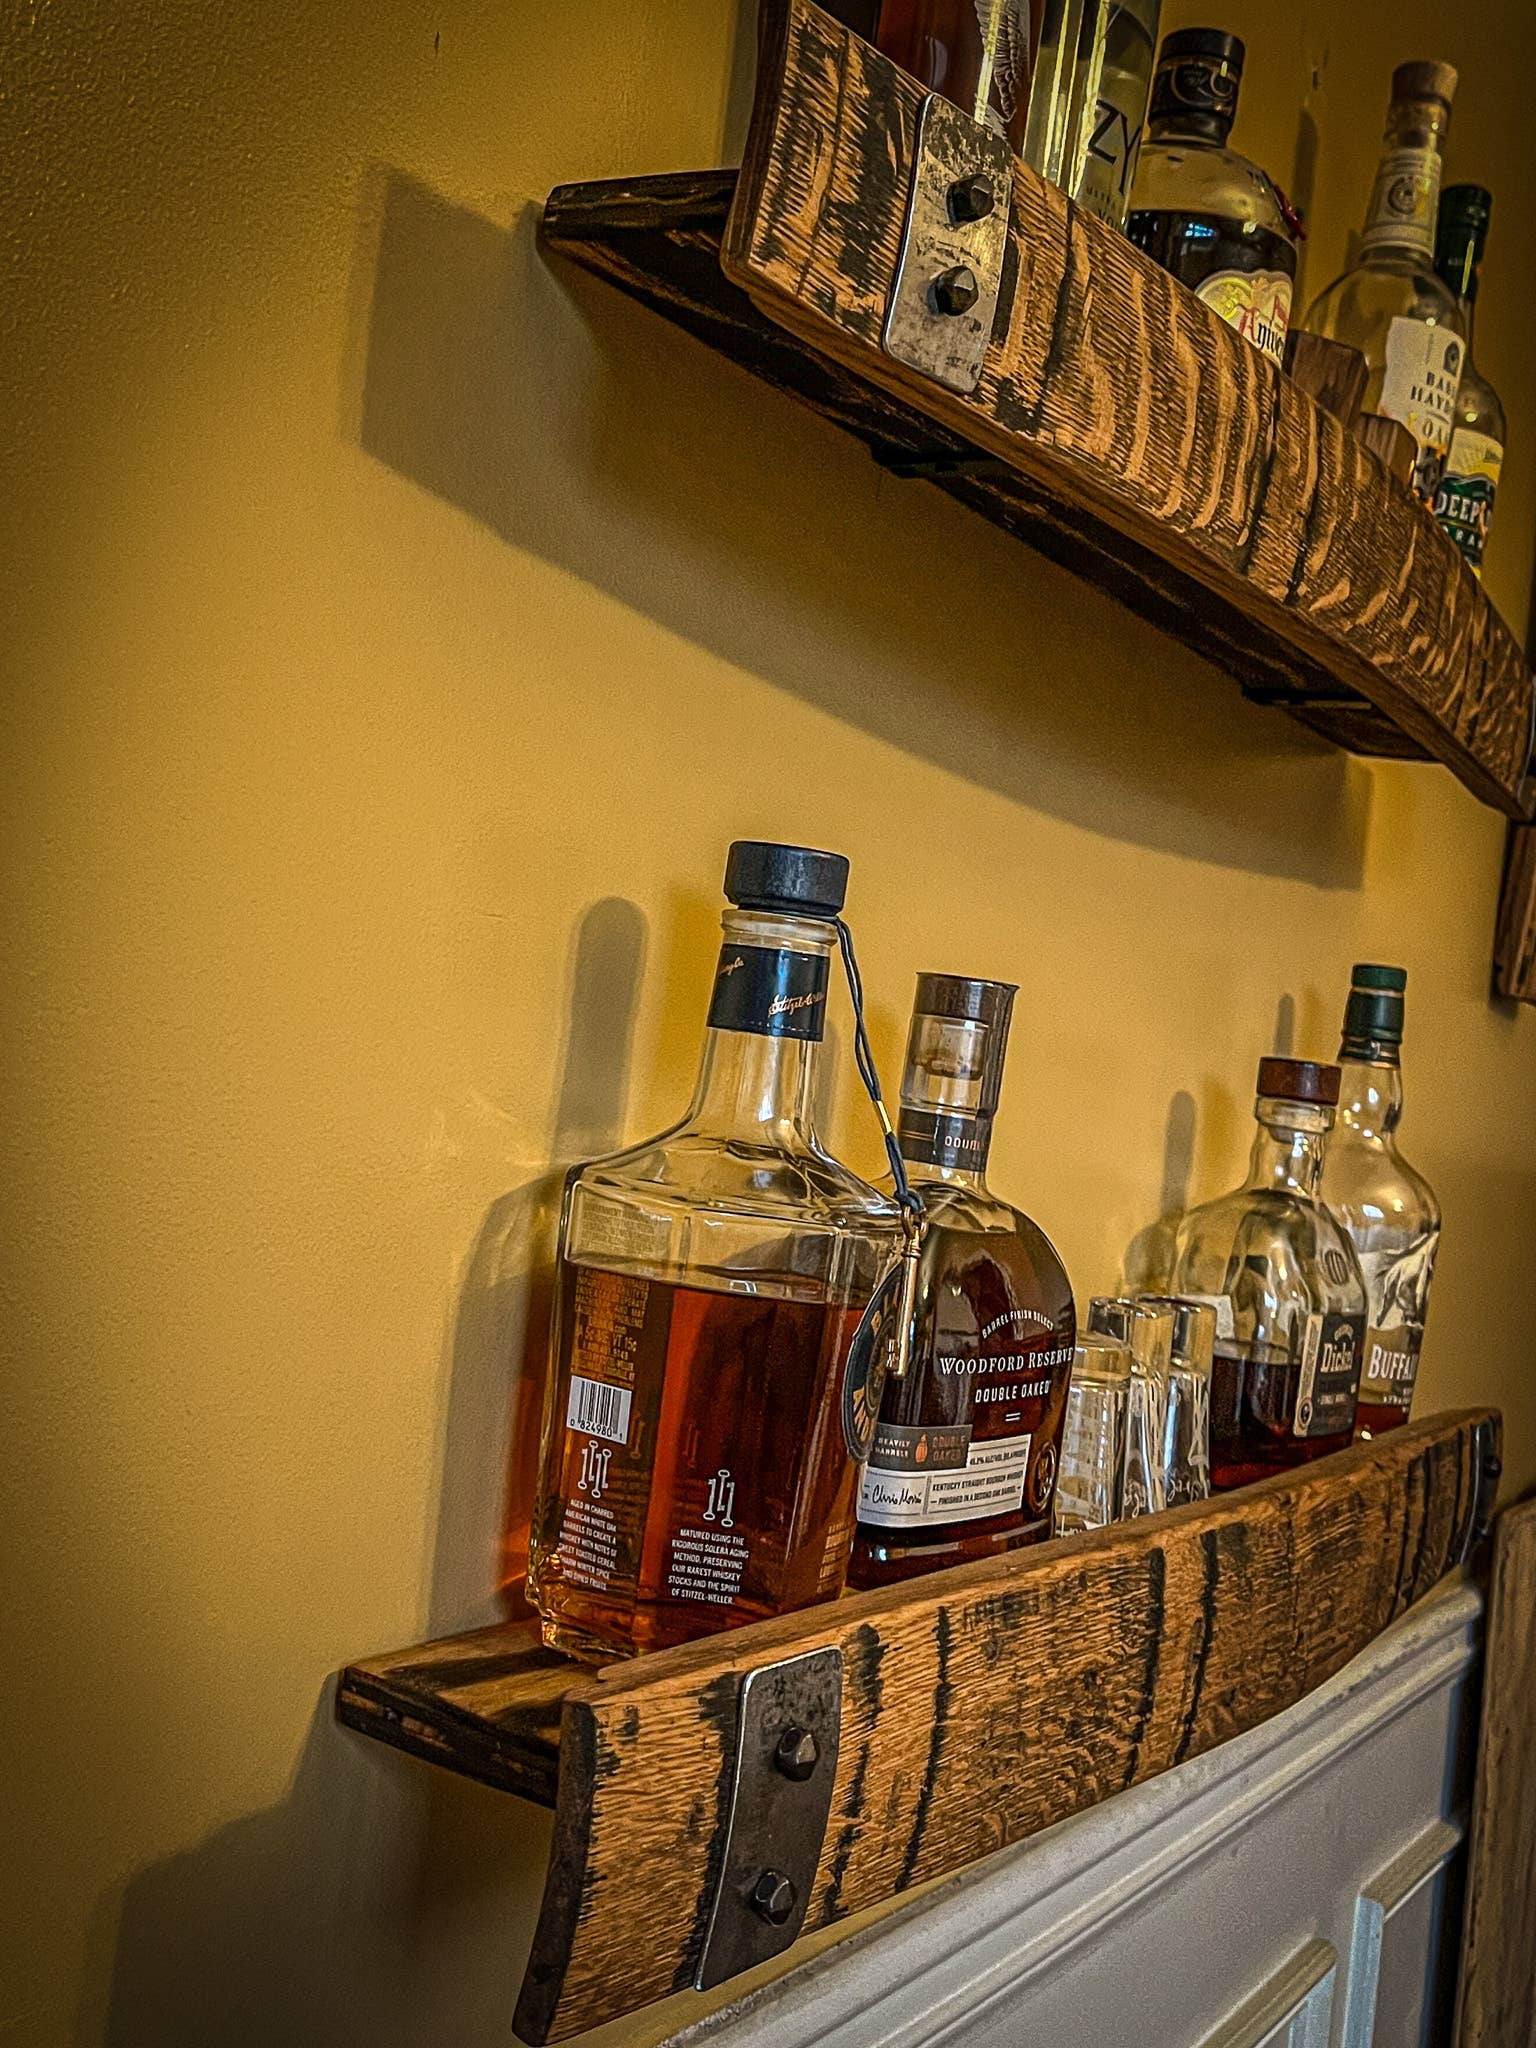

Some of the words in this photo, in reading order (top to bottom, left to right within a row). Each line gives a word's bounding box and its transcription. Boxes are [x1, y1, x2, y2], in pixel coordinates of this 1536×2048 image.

[982, 1314, 1009, 1339] BARREL
[1010, 1309, 1032, 1321] FINISH
[1033, 1310, 1054, 1332] SELECT
[940, 1356, 1024, 1375] WOODFORD
[1028, 1347, 1074, 1369] RESERVE
[975, 1385, 1018, 1403] DOUBLE
[932, 1481, 961, 1492] KENTUCKY
[680, 1528, 710, 1540] MATURED
[711, 1533, 731, 1544] USING
[732, 1536, 745, 1546] THE
[672, 1539, 704, 1552] RIGOROUS
[729, 1548, 749, 1559] AGING
[672, 1563, 686, 1573] OUR
[687, 1566, 711, 1577] RAREST
[712, 1570, 741, 1581] WHISKEY
[702, 1556, 743, 1570] PRESERVING
[668, 1575, 692, 1586] STOCKS
[693, 1579, 706, 1588] AND
[707, 1581, 719, 1591] THE
[720, 1582, 741, 1593] SPIRIT
[671, 1588, 680, 1597] OF
